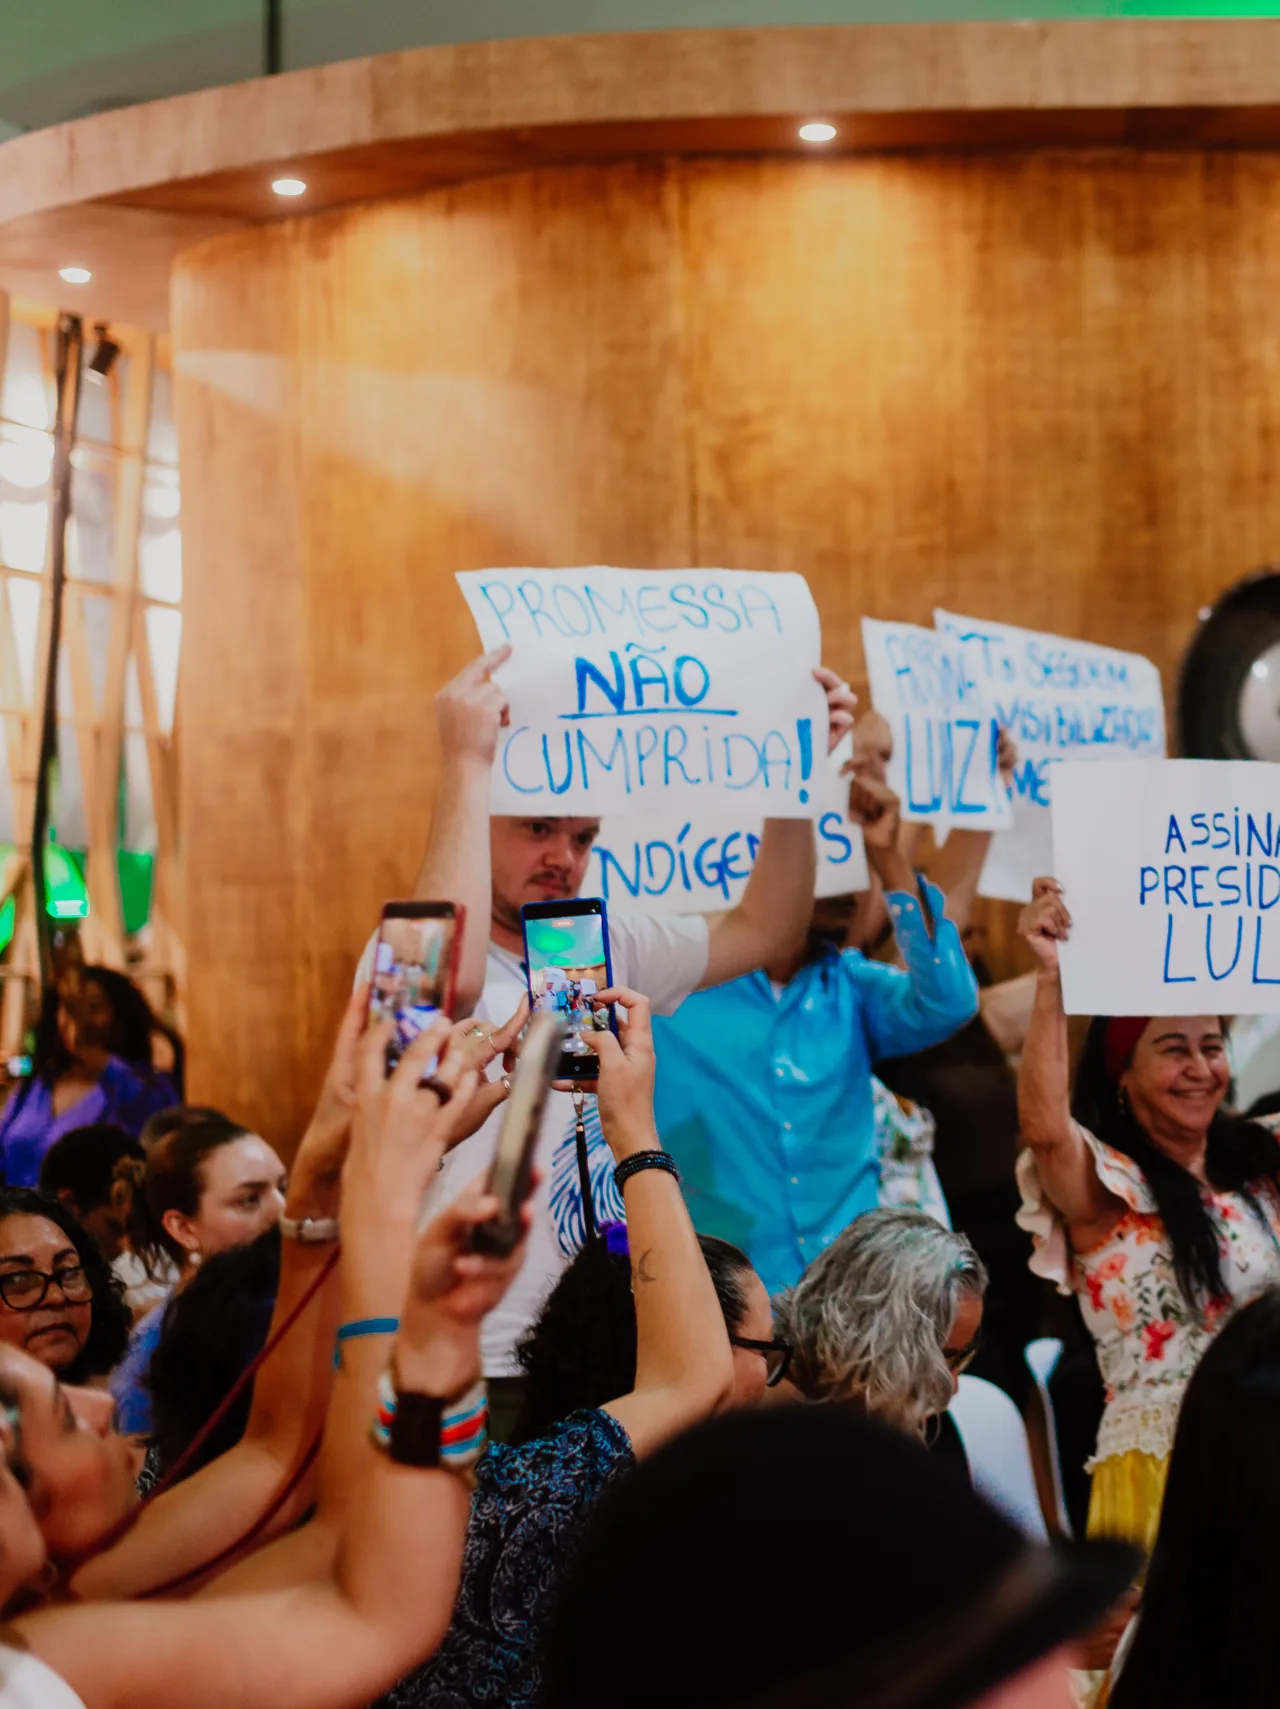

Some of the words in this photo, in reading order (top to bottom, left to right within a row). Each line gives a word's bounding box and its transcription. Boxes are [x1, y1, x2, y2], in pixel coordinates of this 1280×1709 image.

[480, 579, 784, 641] PROMESSA
[574, 642, 711, 715] NÃO
[502, 717, 813, 805] CUMPRIDA!
[591, 812, 853, 901] NDÍGES
